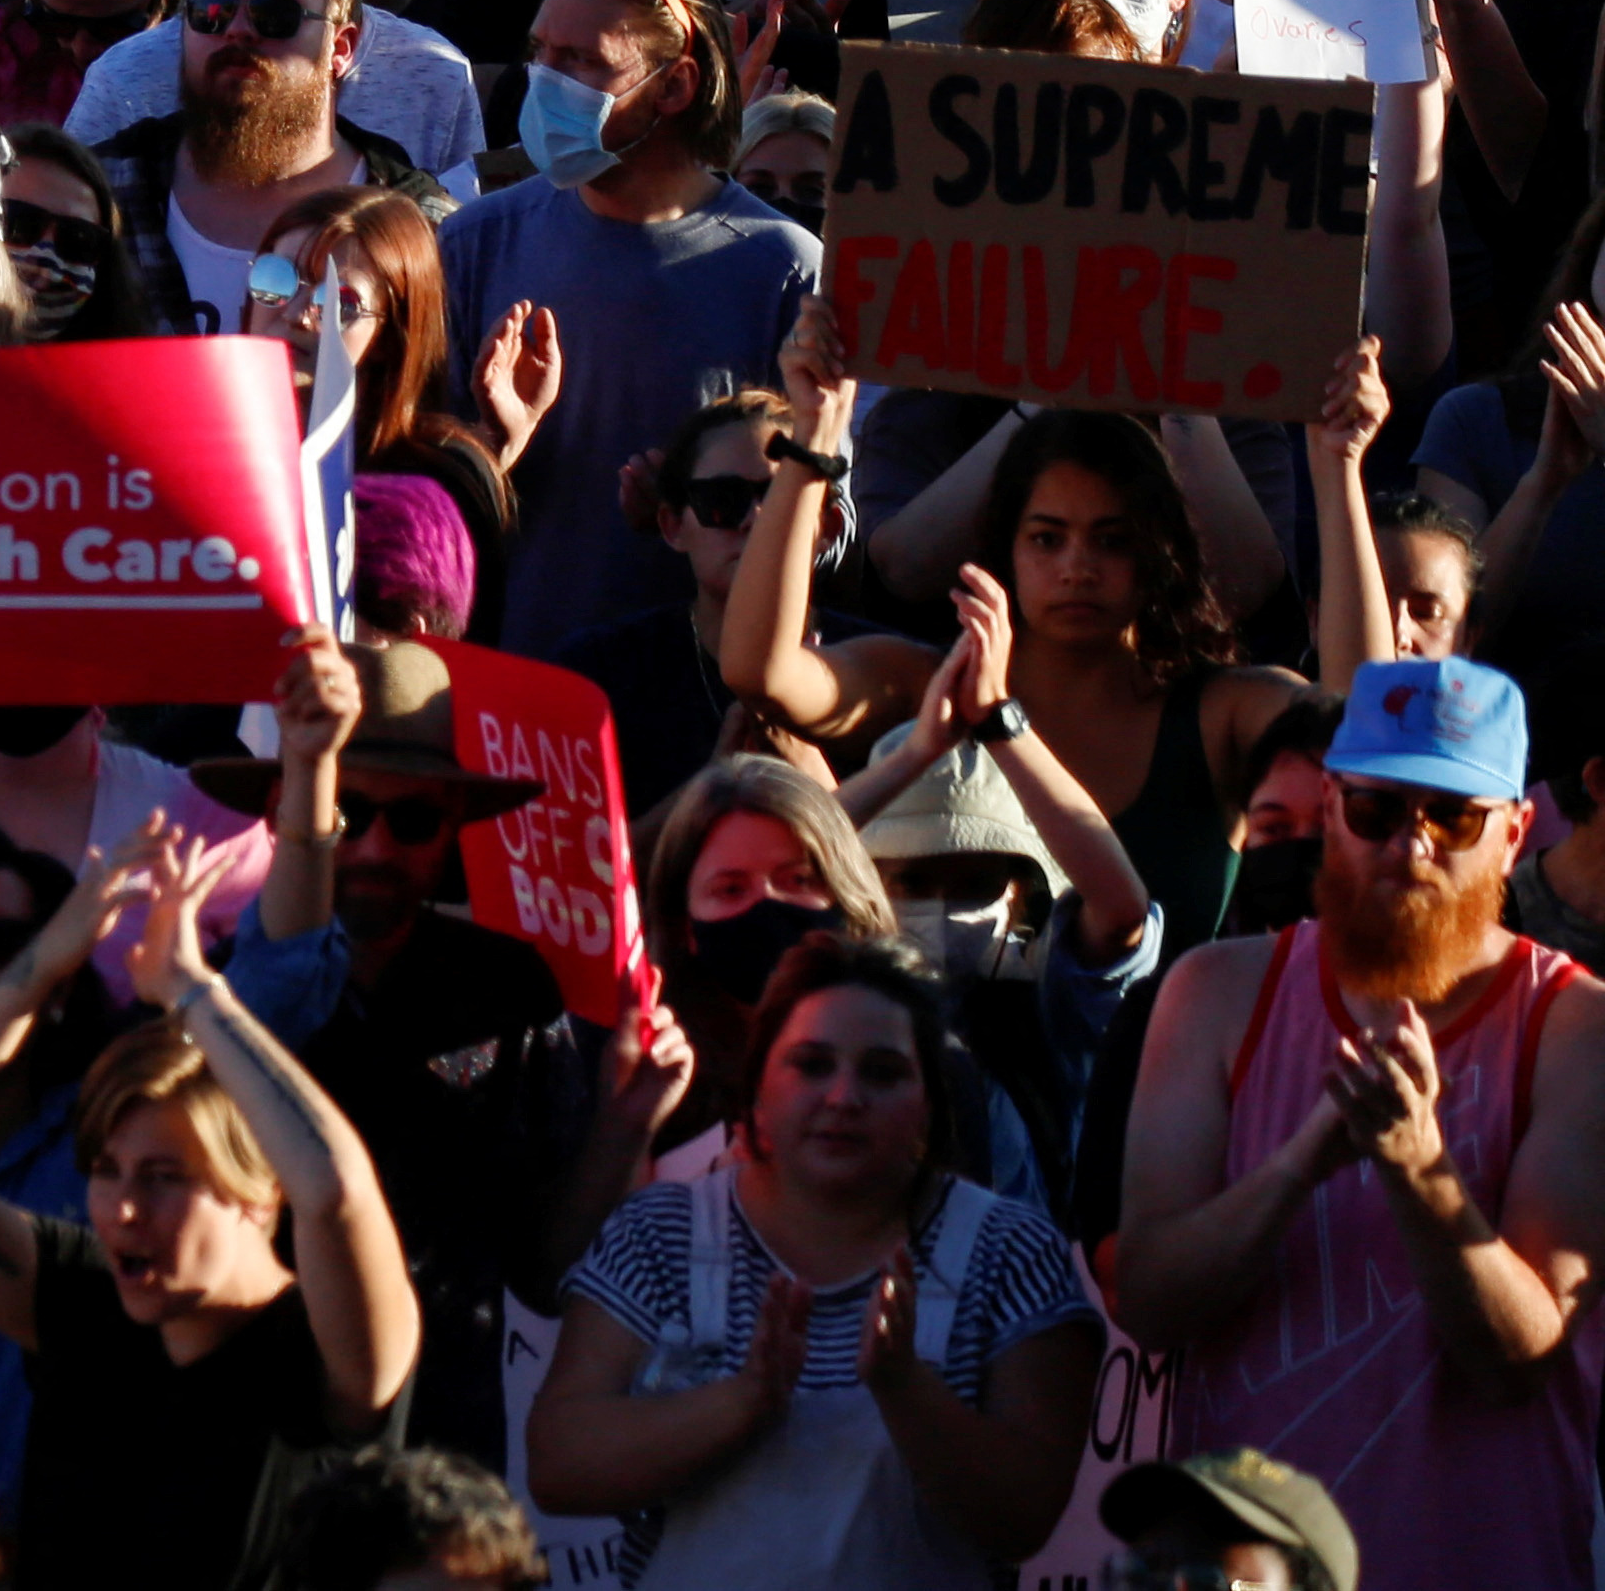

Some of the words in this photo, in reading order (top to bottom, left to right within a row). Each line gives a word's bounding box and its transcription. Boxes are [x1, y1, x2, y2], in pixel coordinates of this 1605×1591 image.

[1251, 6, 1367, 47] Ovaries
[834, 71, 898, 193] A
[931, 73, 1374, 236] SUPREME
[836, 236, 1285, 408] FAILURE.
[107, 455, 153, 509] is
[62, 528, 261, 583] Care.
[479, 713, 603, 808] BANS
